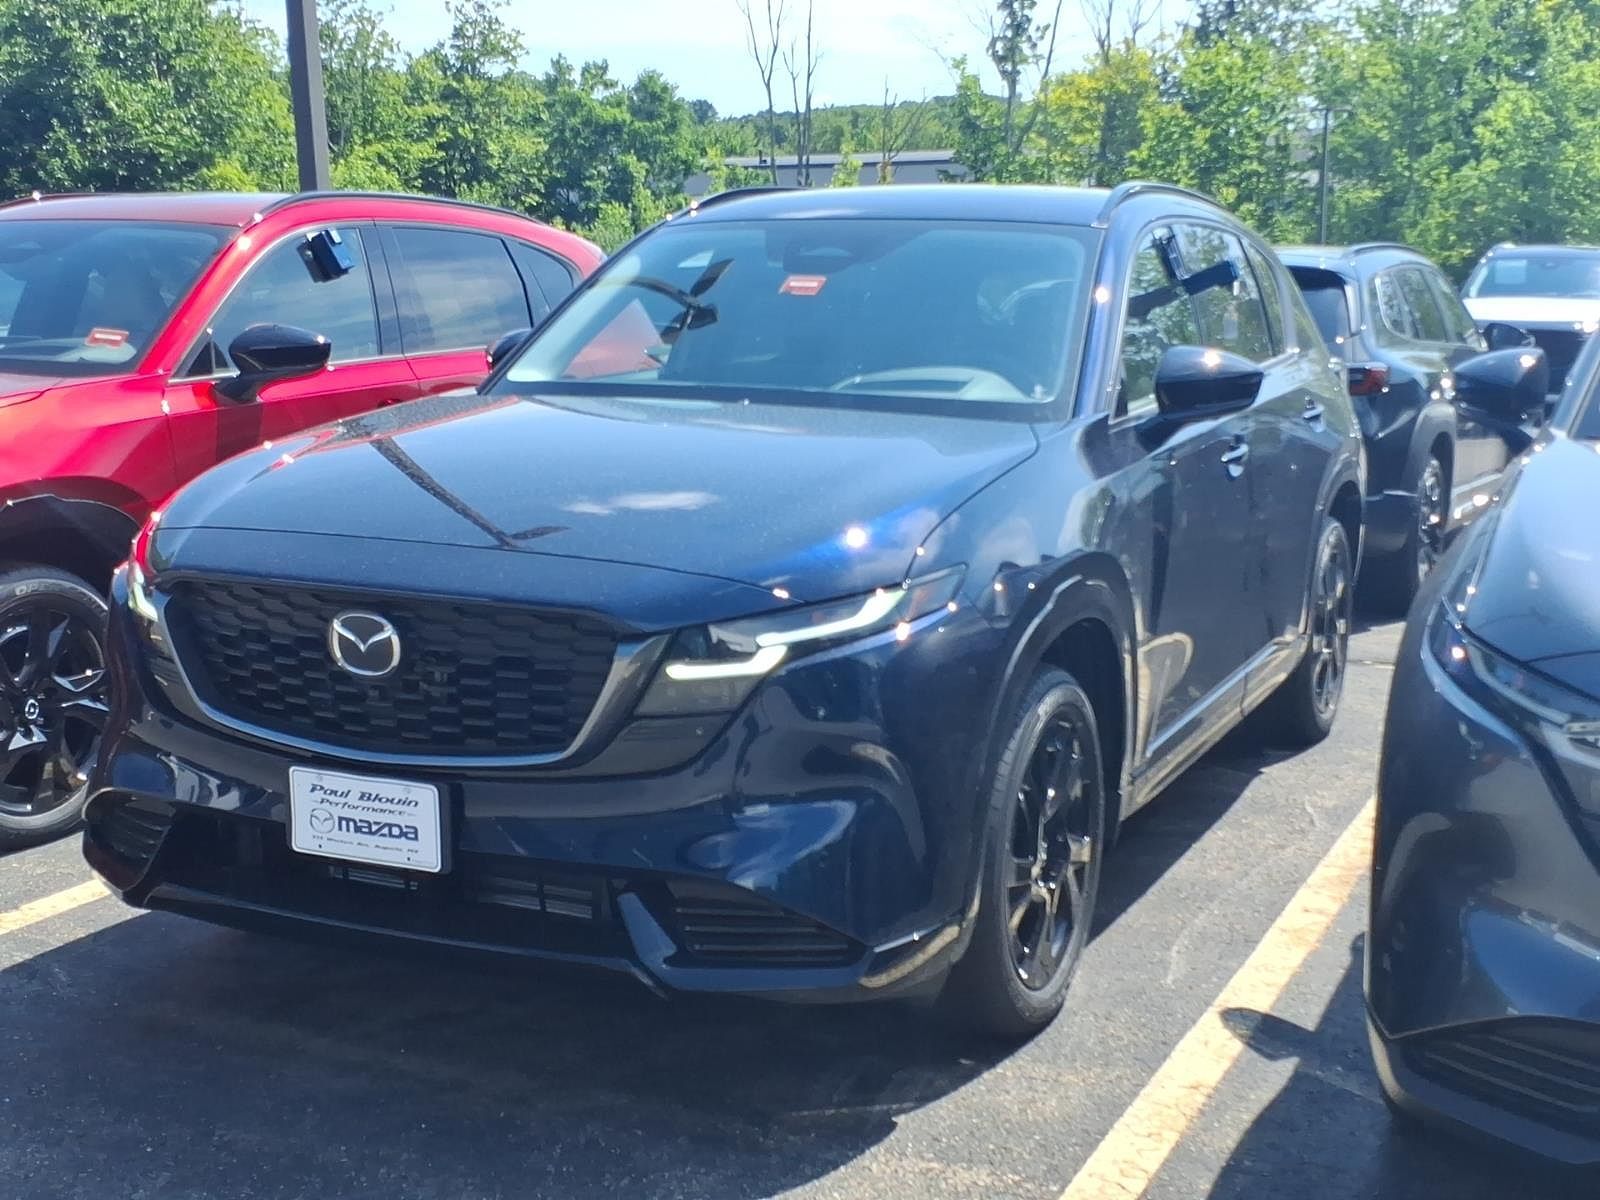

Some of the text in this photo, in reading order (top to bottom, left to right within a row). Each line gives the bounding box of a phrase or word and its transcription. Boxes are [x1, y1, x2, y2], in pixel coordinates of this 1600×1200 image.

[309, 783, 419, 807] Paul Blouin
[319, 798, 406, 816] Performance
